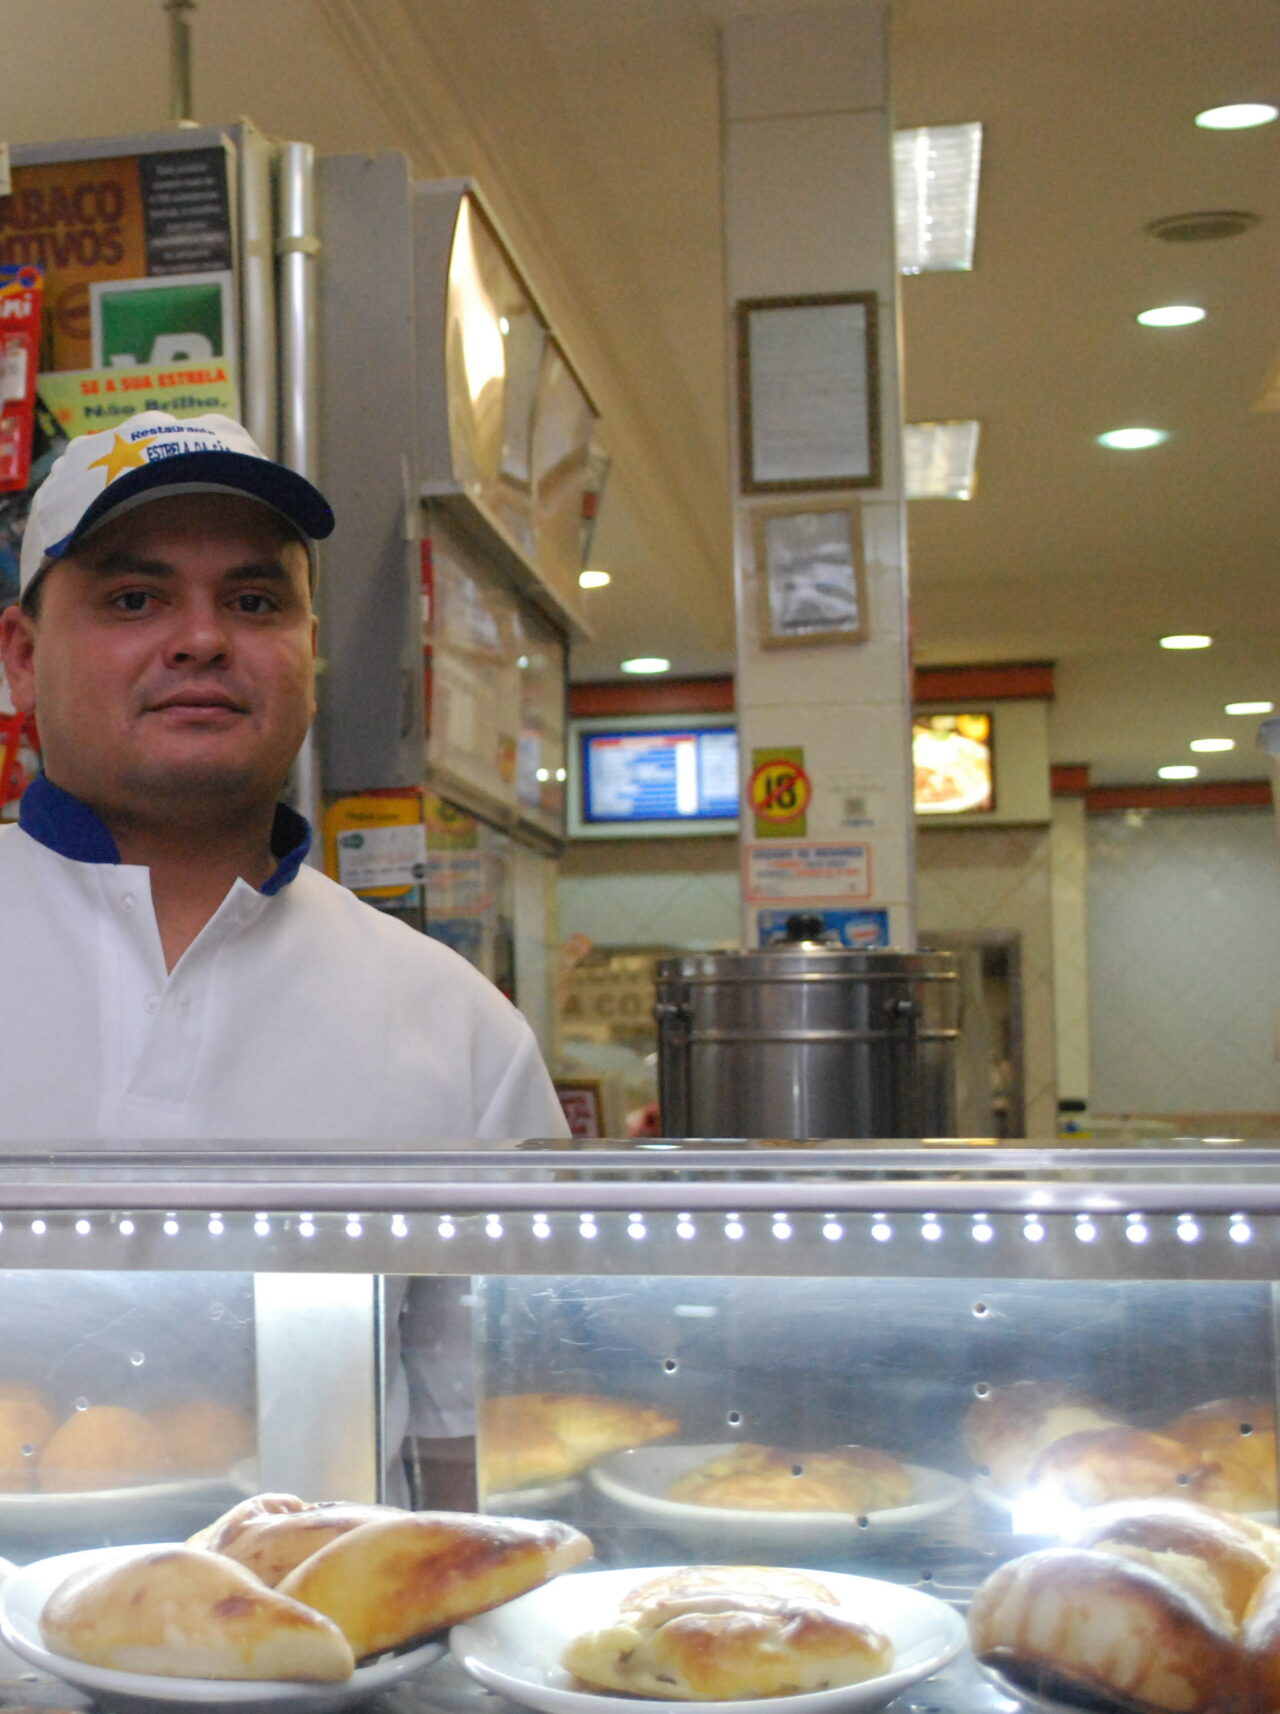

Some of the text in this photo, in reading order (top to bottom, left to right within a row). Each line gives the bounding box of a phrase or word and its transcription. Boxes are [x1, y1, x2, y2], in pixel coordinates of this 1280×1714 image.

[105, 379, 116, 392] A
[121, 375, 153, 392] SUA
[158, 368, 227, 388] ESTRELA
[765, 773, 798, 810] 18
